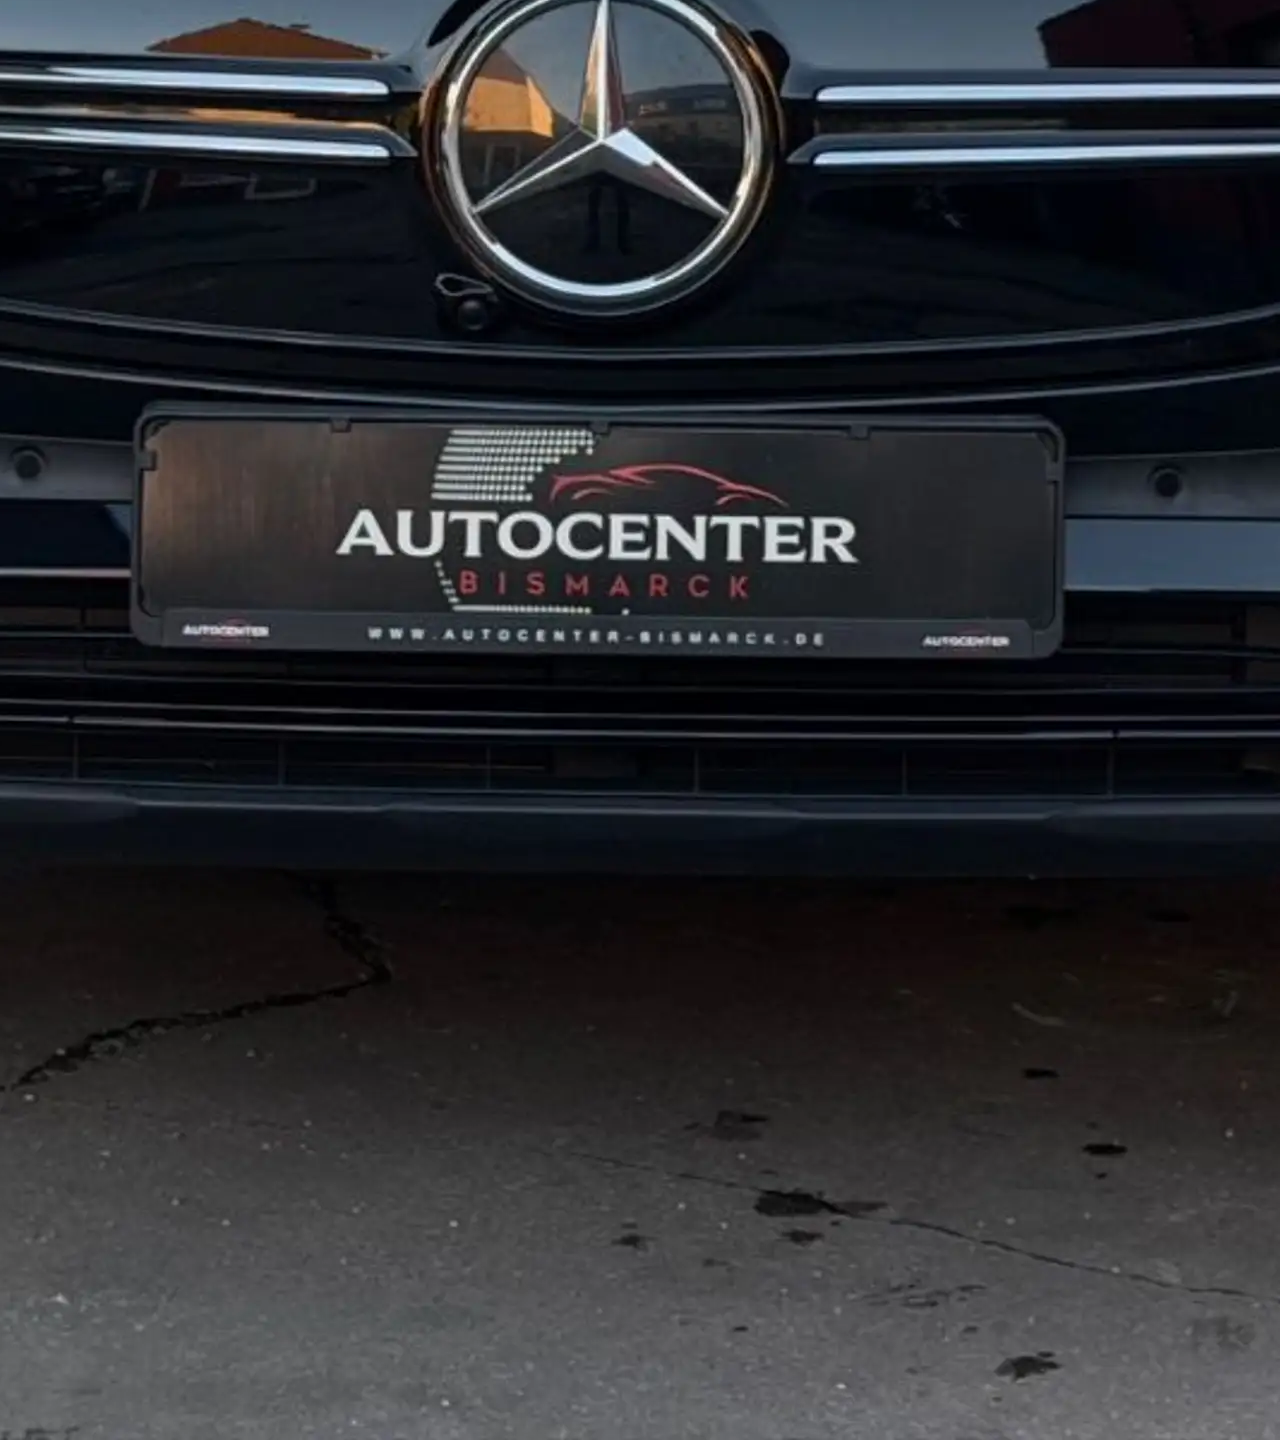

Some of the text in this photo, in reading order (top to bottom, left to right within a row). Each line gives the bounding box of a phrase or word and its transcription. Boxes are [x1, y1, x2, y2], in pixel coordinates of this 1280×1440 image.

[336, 509, 859, 563] AUTOCENTER
[458, 570, 749, 599] BISMARCK
[181, 622, 271, 638] AUTOCENTER
[366, 626, 826, 647] WWW.AUTOCENTER-BISMARCK.DE
[922, 634, 1011, 648] AUTOCENTER
